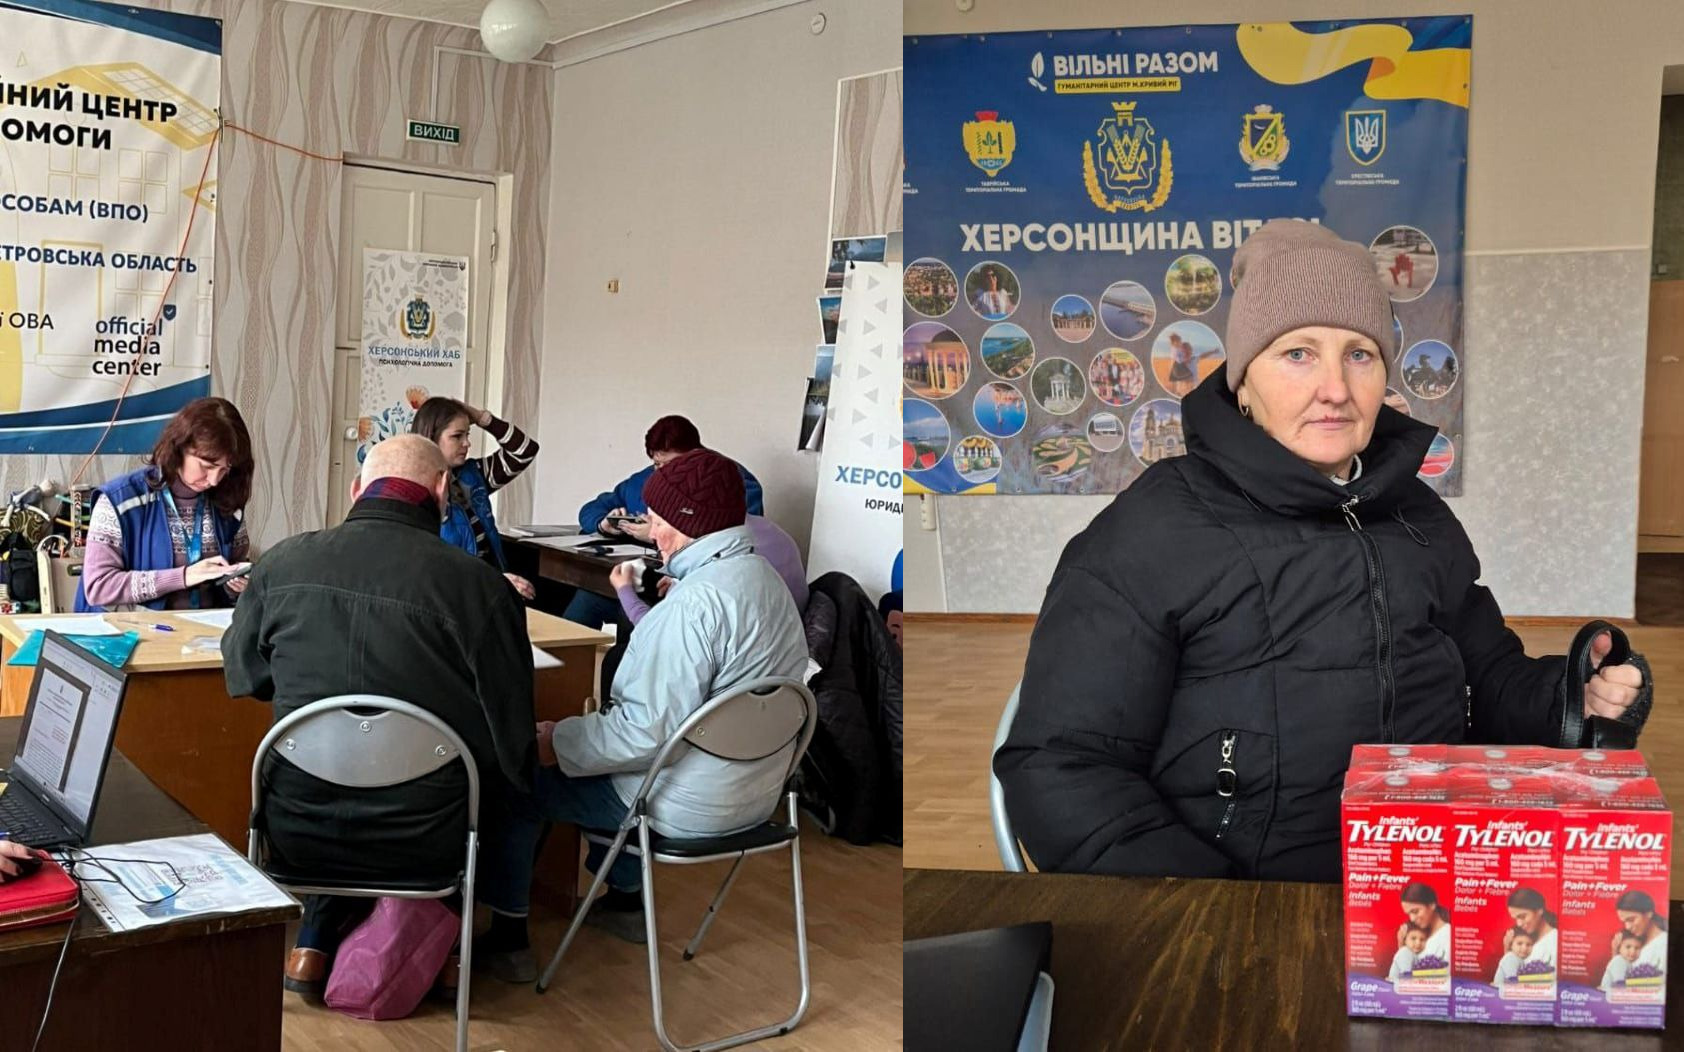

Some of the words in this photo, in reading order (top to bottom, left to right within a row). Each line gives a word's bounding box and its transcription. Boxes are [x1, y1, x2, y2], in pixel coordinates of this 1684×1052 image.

[1053, 53, 1130, 76] ВІЛЬНІ
[1135, 51, 1219, 74] РАЗОМ
[82, 92, 177, 122] ЦЕНТР
[1, 118, 112, 150] ОМОГИ
[414, 124, 455, 141] ВИХІД
[0, 194, 83, 216] СОБАМ
[89, 200, 148, 223] (ВПО)
[960, 221, 1203, 255] ХЕРСОНЩИНА
[111, 253, 197, 273] ОБЛАСТЬ
[9, 312, 54, 329] ОВА
[95, 316, 162, 336] official
[94, 336, 160, 355] media
[442, 349, 461, 359] ХАБ
[92, 359, 161, 376] center
[835, 465, 902, 489] ХЕРСО
[1347, 820, 1444, 842] TYLENOL
[1454, 824, 1553, 847] TYLENOL
[1563, 827, 1665, 850] TYLENOL
[1349, 891, 1381, 901] Infants
[1455, 896, 1487, 906] Infants
[1562, 899, 1596, 909] Infants
[1350, 981, 1378, 993] Grape
[1454, 986, 1482, 999] Grape
[1560, 990, 1589, 1002] Grape
